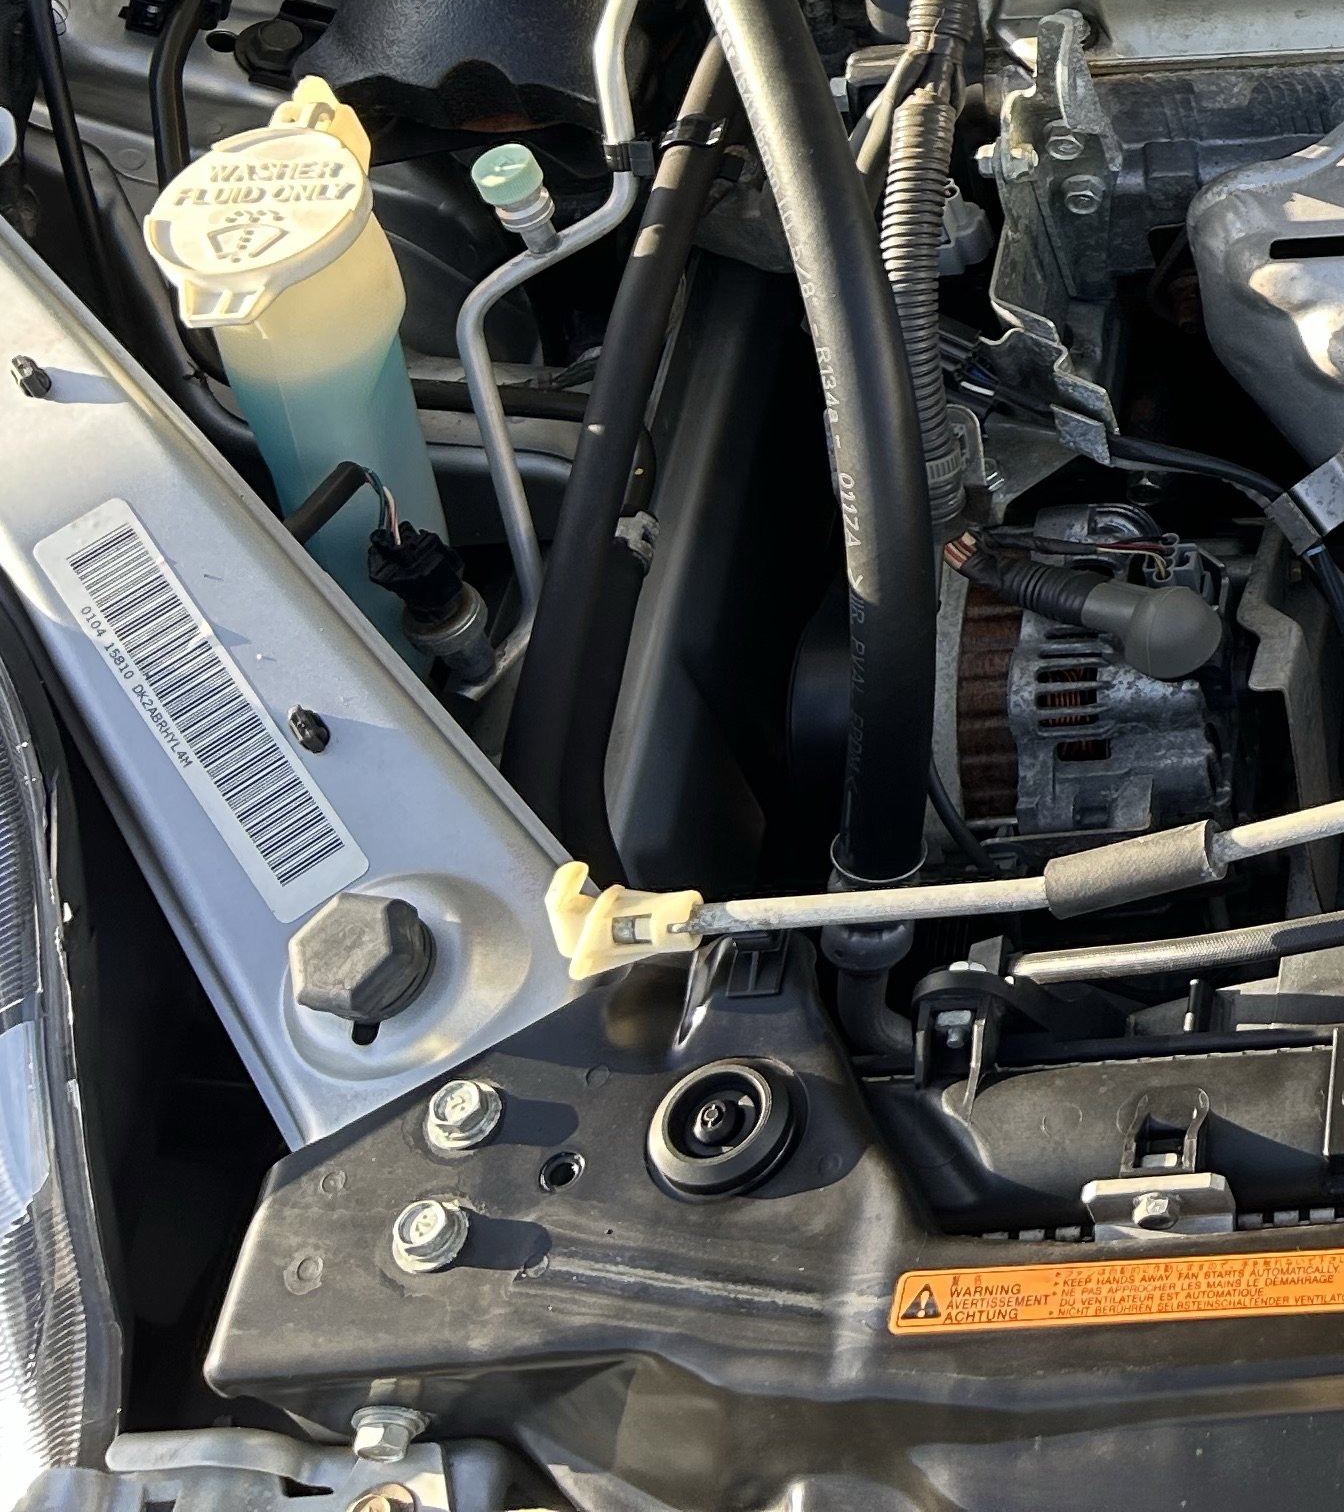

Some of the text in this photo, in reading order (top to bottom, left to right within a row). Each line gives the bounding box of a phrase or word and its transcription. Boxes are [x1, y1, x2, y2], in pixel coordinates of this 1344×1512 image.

[208, 161, 346, 184] WASHER
[172, 181, 357, 207] FLUID ONLY
[80, 605, 194, 770] 0104 15810 DK2ABRHYL4M
[1061, 1287, 1076, 1297] NE
[1081, 1286, 1103, 1296] PAS
[1107, 1282, 1176, 1294] APPROCHER
[1181, 1280, 1202, 1291] LES
[1206, 1279, 1242, 1289] MAINS
[1246, 1277, 1259, 1287] LE
[1062, 1277, 1092, 1288] KEEP
[1096, 1275, 1135, 1286] HANDS
[1139, 1272, 1173, 1283] AWAY
[1177, 1271, 1199, 1281] FAN
[1204, 1269, 1245, 1279] STARTS
[950, 1283, 1022, 1298] WARNING
[1059, 1288, 1265, 1307] DU VENTILATEUR EST AUTOMATIQUE
[946, 1294, 1051, 1311] AVERTISSEMENT
[1058, 1306, 1090, 1317] NICHT
[943, 1308, 1019, 1325] ACHTUNG
